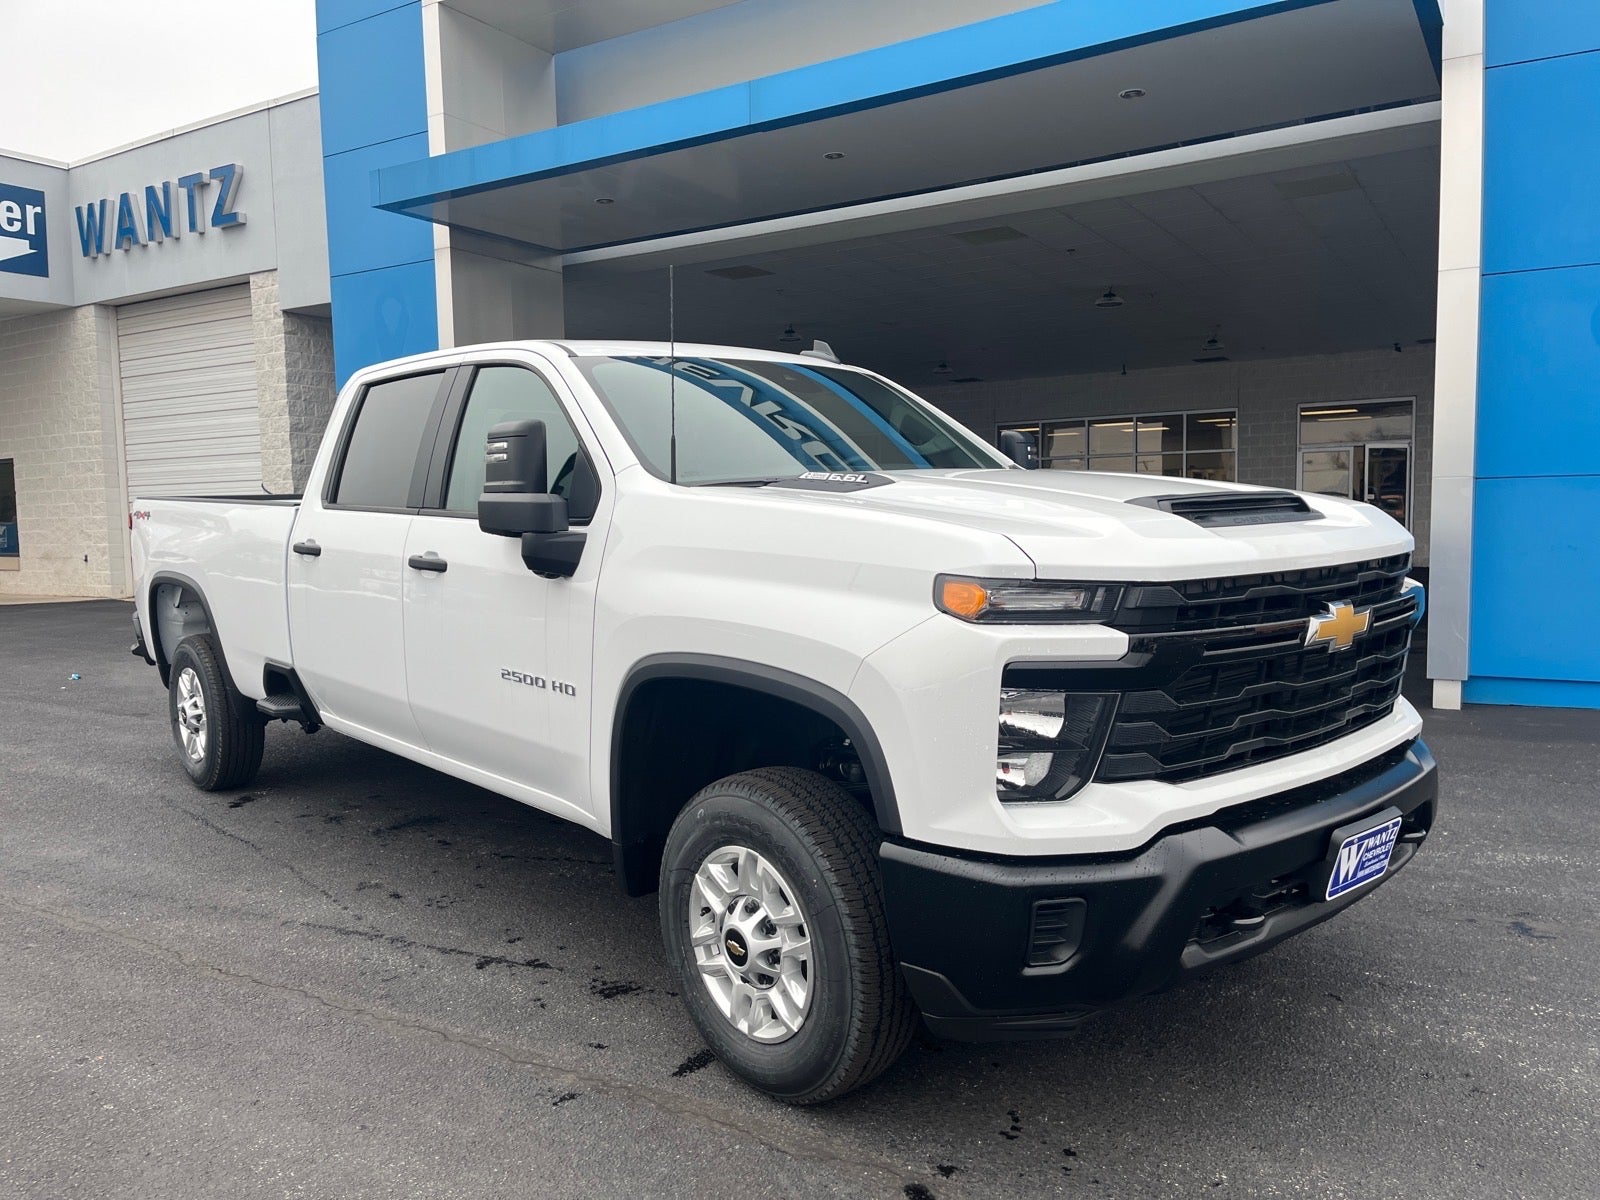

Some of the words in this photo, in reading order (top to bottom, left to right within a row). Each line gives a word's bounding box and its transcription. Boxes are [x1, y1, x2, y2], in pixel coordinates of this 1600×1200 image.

[0, 200, 42, 236] er
[75, 163, 247, 258] WANTZ
[501, 668, 546, 689] 2500
[551, 680, 576, 697] HD
[1362, 842, 1393, 861] CHEVROLET
[1367, 826, 1398, 849] WANTZ
